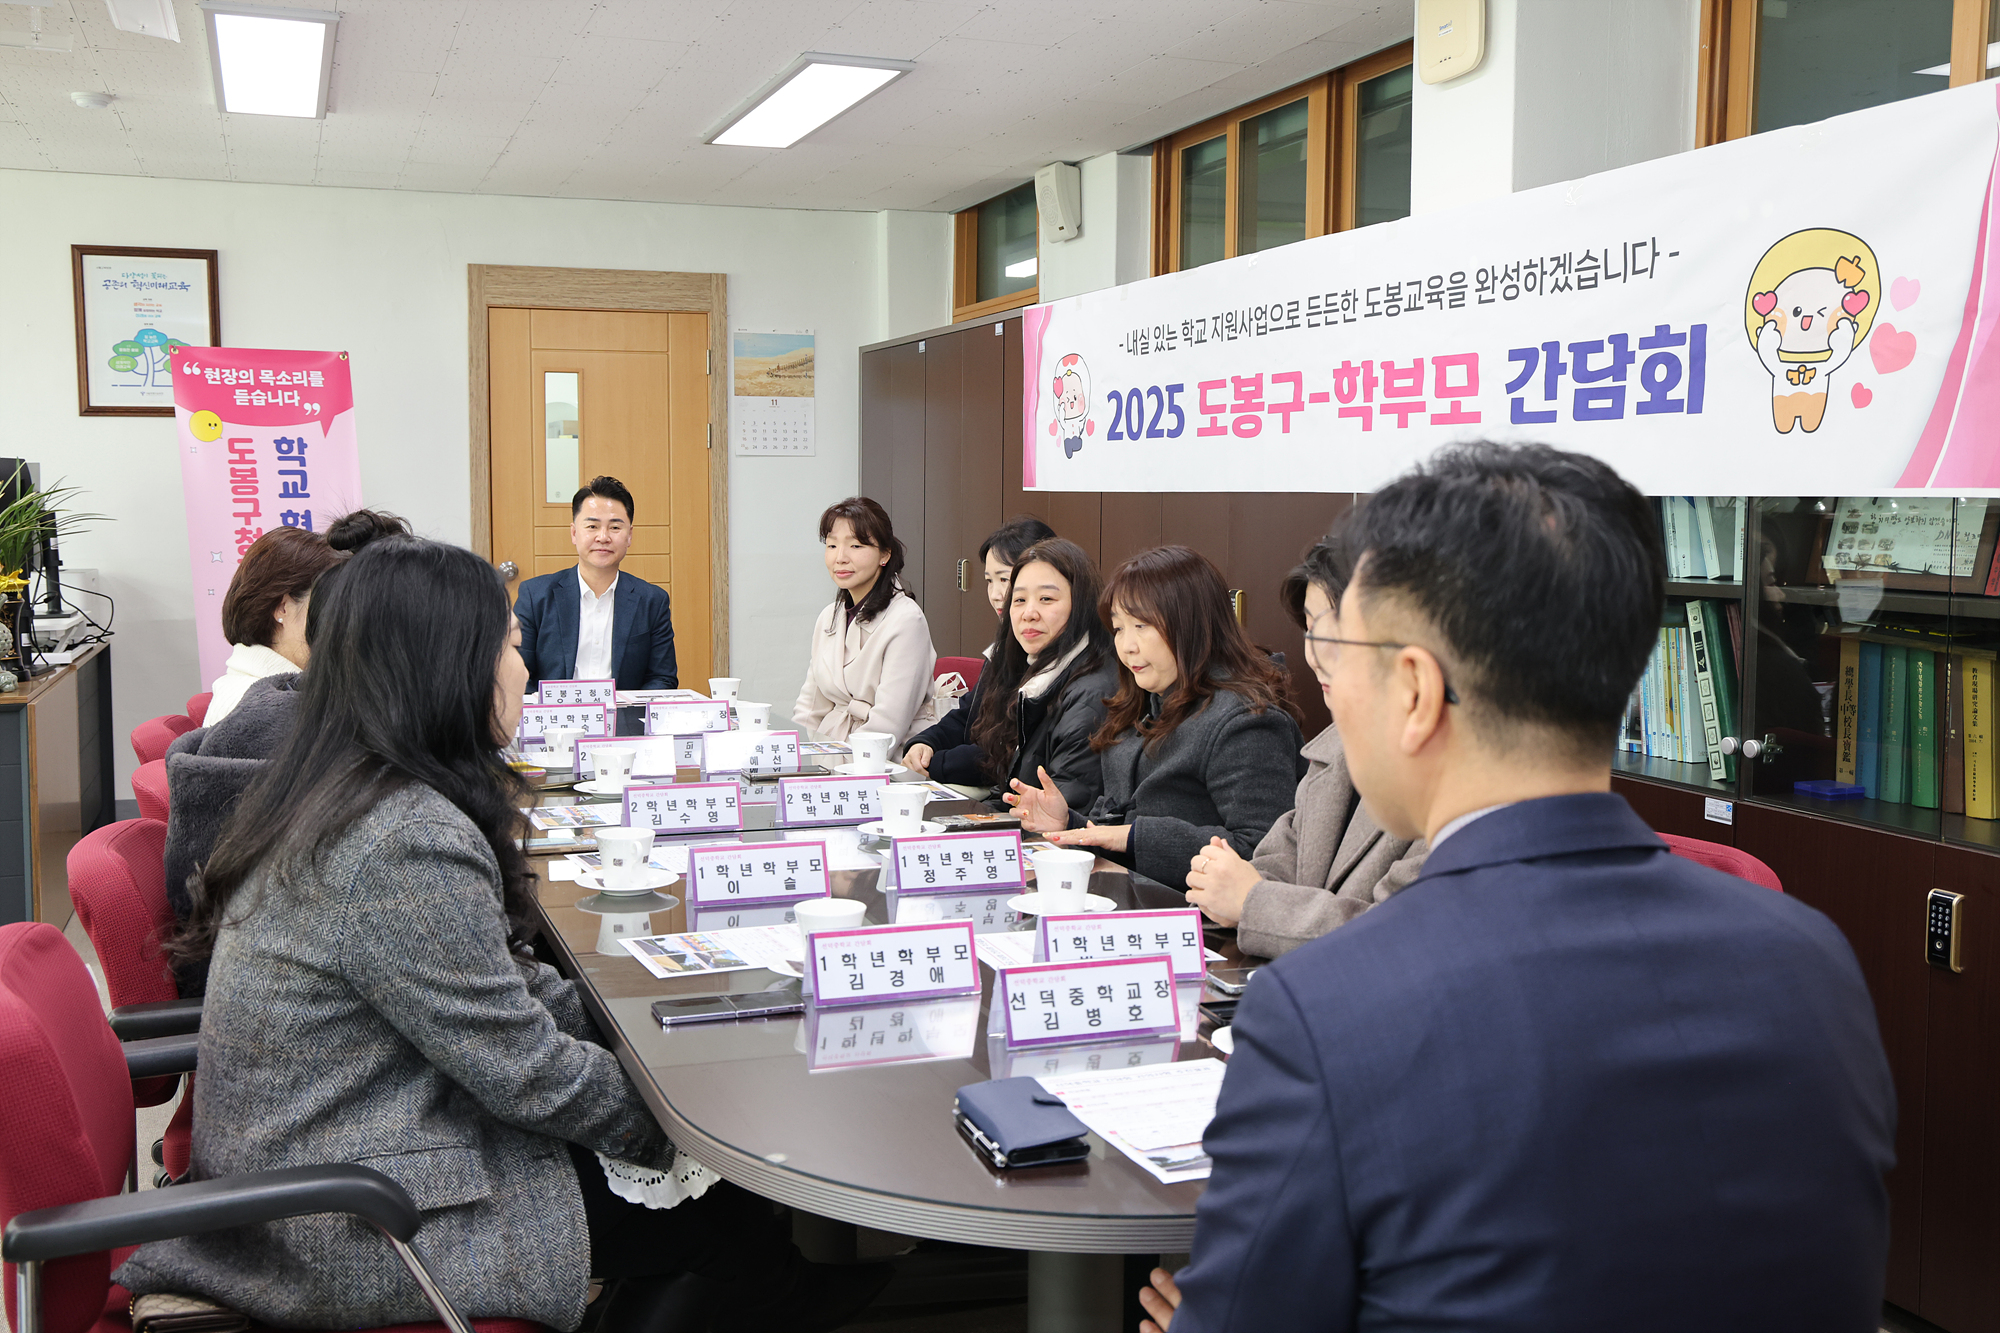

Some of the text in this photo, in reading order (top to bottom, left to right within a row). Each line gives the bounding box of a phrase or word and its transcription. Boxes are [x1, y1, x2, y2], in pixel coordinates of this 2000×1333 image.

[102, 279, 192, 292] 공존의 혁신미래교육
[1126, 327, 1150, 356] 내실
[1153, 324, 1177, 353] 있는
[1181, 318, 1208, 347] 학교
[1211, 301, 1301, 342] 지원사업으로
[1305, 289, 1359, 329] 든든한
[1364, 271, 1468, 318] 도봉교육을
[1475, 237, 1660, 305] 완성하겠습니다
[204, 367, 325, 387] 현장의 목소리를
[1107, 323, 1708, 441] 2025 도봉구-학부모 간담회
[233, 389, 300, 406] 듣습니다
[273, 436, 310, 498] 학교
[228, 438, 263, 564] 도봉구청
[545, 689, 611, 698] 도봉구청장
[651, 811, 718, 825] 김수영
[806, 803, 870, 817] 박세연
[924, 866, 998, 883] 정주영
[849, 966, 945, 991] 김경애
[1010, 979, 1170, 1011] 선덕중학교장
[1043, 1004, 1143, 1030] 김병호
